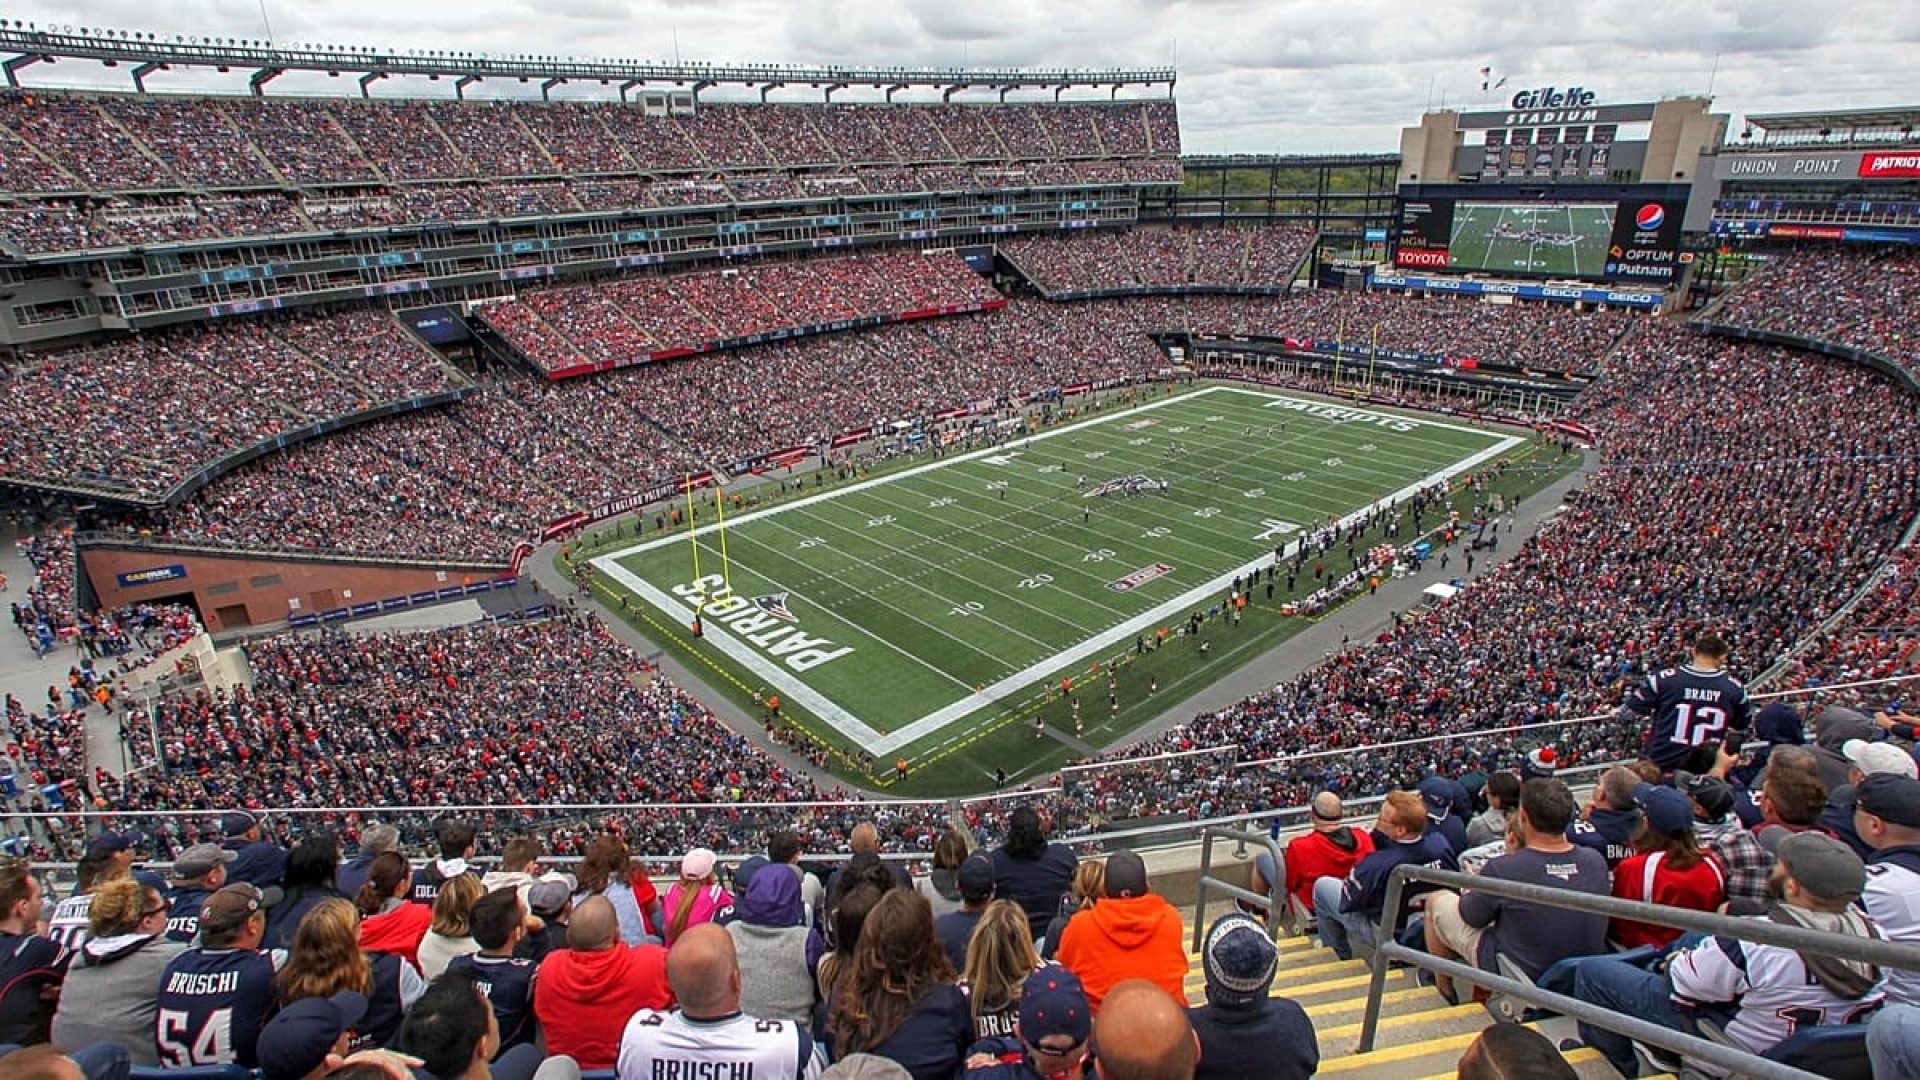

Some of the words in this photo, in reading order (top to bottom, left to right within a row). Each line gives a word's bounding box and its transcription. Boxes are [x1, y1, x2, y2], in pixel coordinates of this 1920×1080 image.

[1511, 87, 1596, 110] Gillette
[1505, 109, 1598, 125] STADIUM
[1731, 159, 1778, 174] UNION
[1793, 159, 1841, 174] POINT
[1397, 252, 1446, 264] TOYOTA
[1626, 249, 1674, 262] OPTUM
[1617, 263, 1672, 277] Putnam
[1542, 288, 1583, 298] GEICO
[1607, 292, 1651, 303] GEICO
[1263, 399, 1421, 432] PATRIOTS
[1017, 573, 1054, 589] 20
[948, 601, 985, 617] 10
[671, 572, 856, 673] PATRIOTS
[1684, 687, 1721, 702] BRADY
[1669, 703, 1728, 747] 12
[166, 970, 239, 995] BRUSCHI
[158, 1006, 238, 1068] 54
